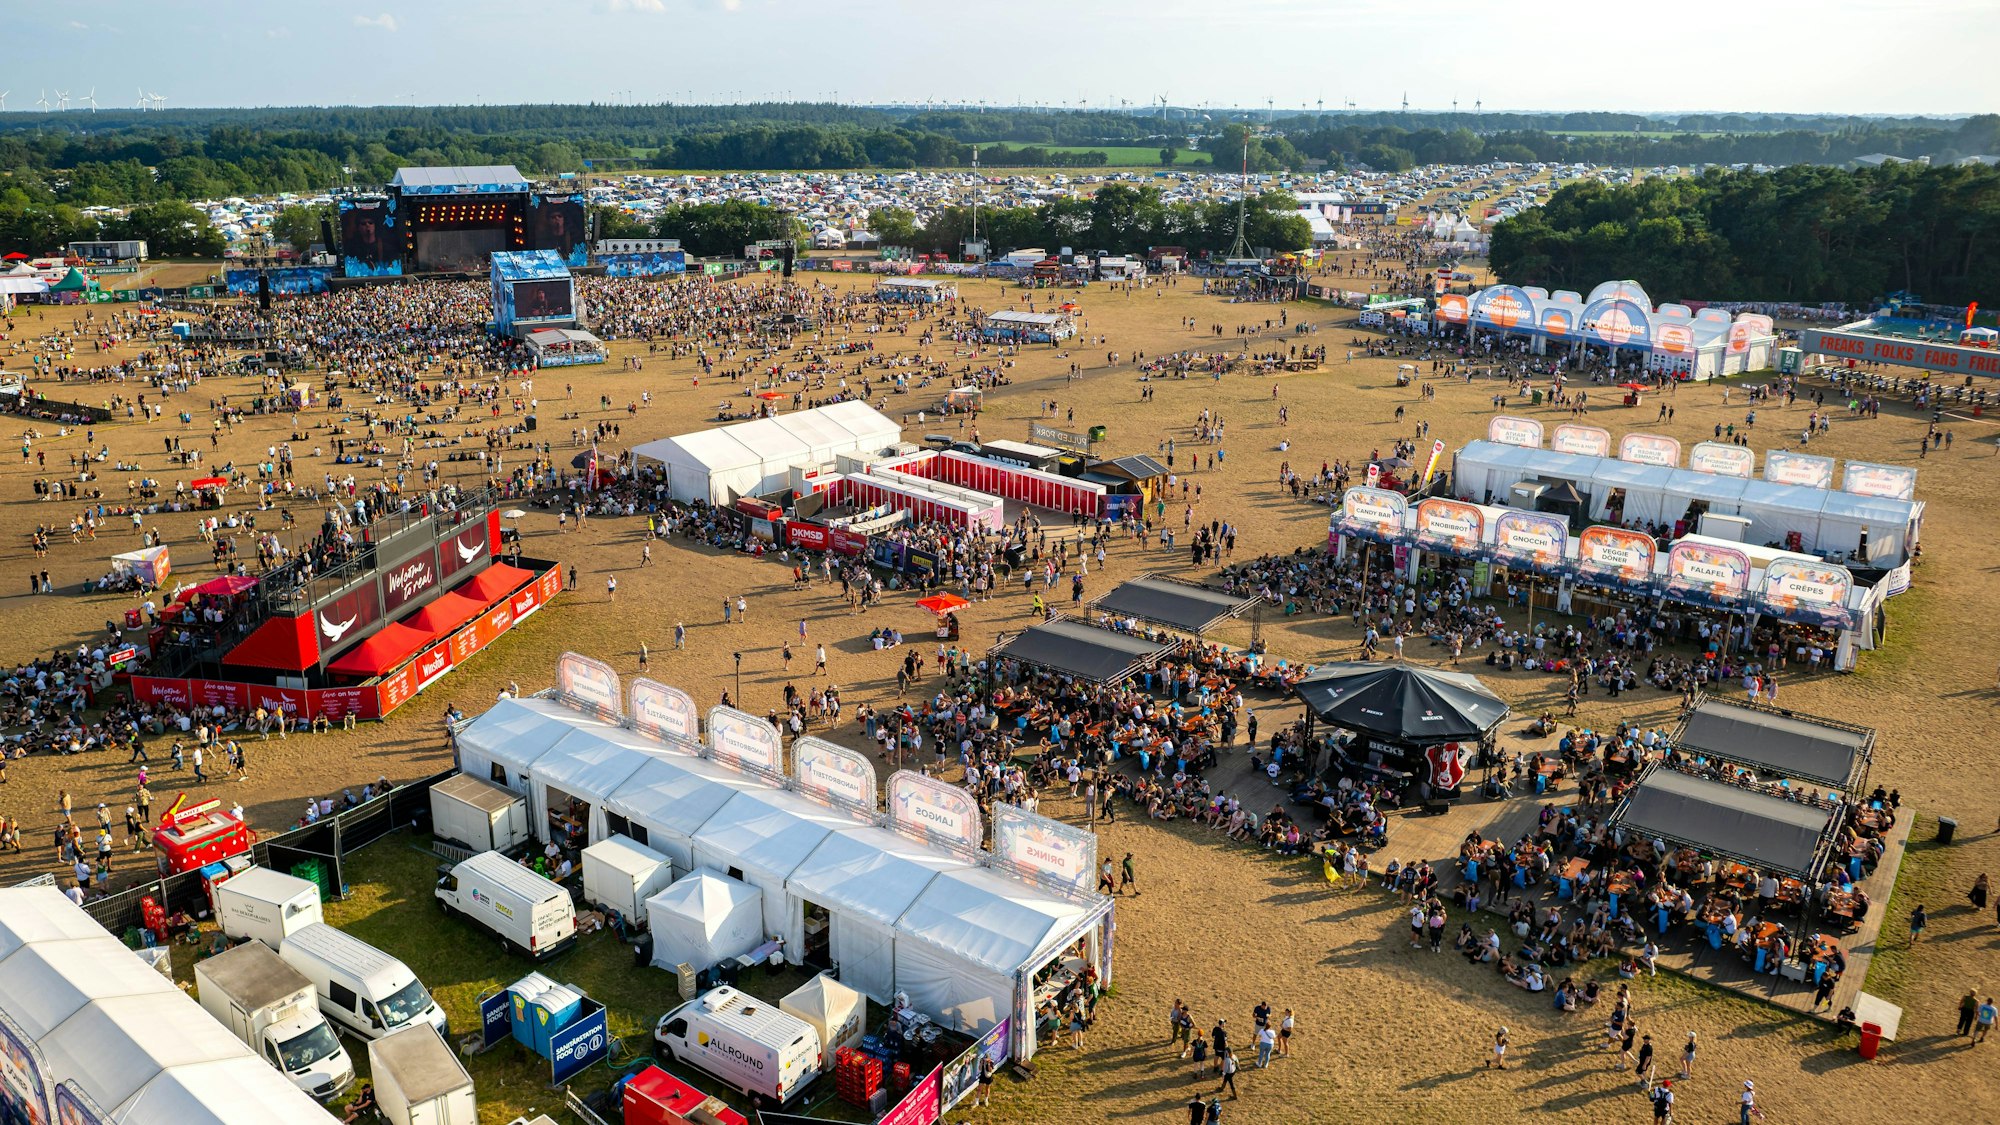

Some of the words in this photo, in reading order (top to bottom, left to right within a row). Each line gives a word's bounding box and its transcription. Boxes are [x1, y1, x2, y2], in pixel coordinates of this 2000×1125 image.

[1820, 336, 1864, 354] FREAKS
[1874, 343, 1914, 361] FOLKS
[1925, 351, 1958, 367] FANS
[1356, 508, 1377, 518] CANDY
[1378, 511, 1392, 519] BAR
[1430, 521, 1468, 532] KNOBIBROT
[792, 528, 816, 540] DKMS
[1512, 536, 1548, 546] GNOCCHI
[1602, 548, 1628, 558] VEGGIE
[1602, 553, 1628, 564] DÖNER
[389, 562, 425, 594] Welcome
[1690, 566, 1726, 578] FALAFEL
[404, 581, 412, 600] to
[414, 566, 433, 592] real
[1789, 582, 1824, 596] CRÊPES
[516, 594, 534, 614] Winston
[422, 656, 444, 678] Winston
[152, 684, 182, 696] Welcome
[347, 690, 361, 698] tour
[172, 694, 188, 704] real
[1368, 740, 1405, 757] BECK'S
[487, 1012, 504, 1025] FOOD
[556, 1024, 602, 1056] SANITÄRSTATION
[556, 1049, 574, 1062] FOOD
[710, 1038, 764, 1070] ALLROUND
[790, 1045, 812, 1064] ALLROUND
